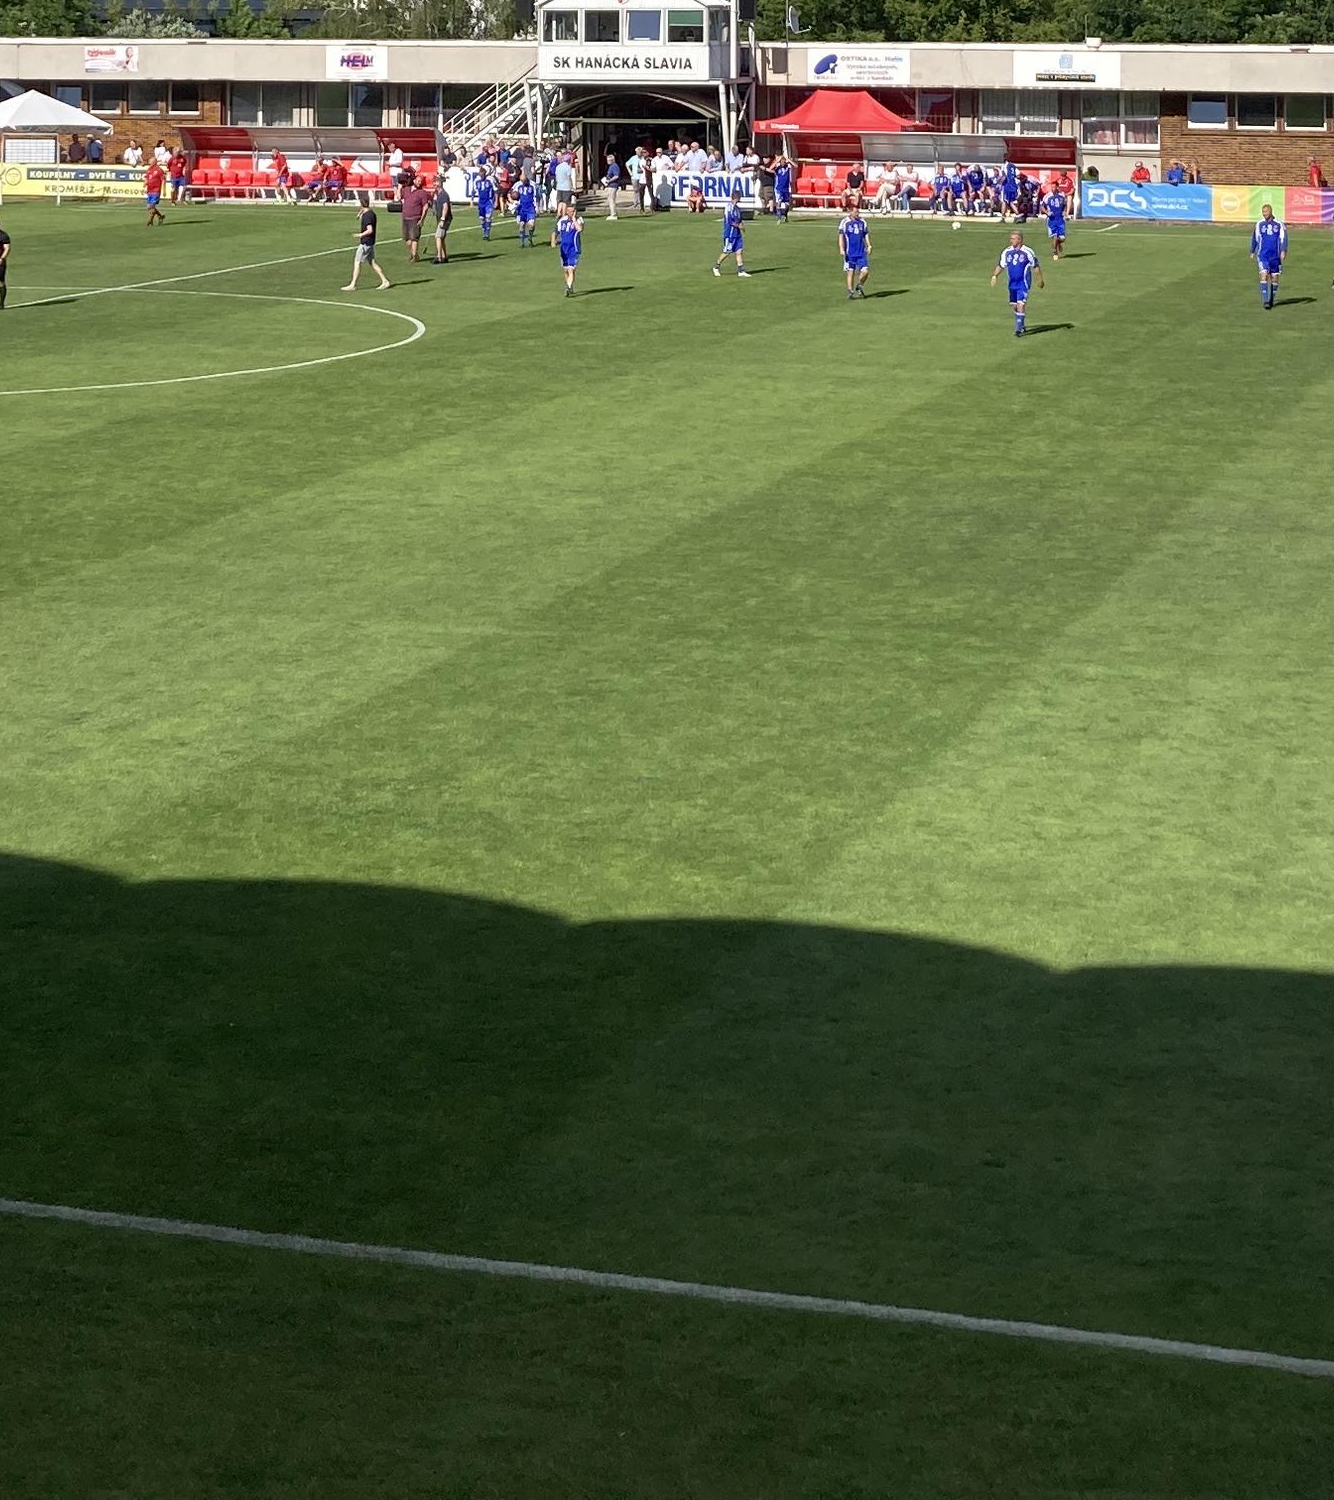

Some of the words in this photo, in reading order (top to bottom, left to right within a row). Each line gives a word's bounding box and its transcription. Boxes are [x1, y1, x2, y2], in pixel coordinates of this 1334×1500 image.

[553, 56, 571, 69] SK
[575, 54, 640, 69] HANÁCKÁ
[644, 57, 693, 70] SLAVIA
